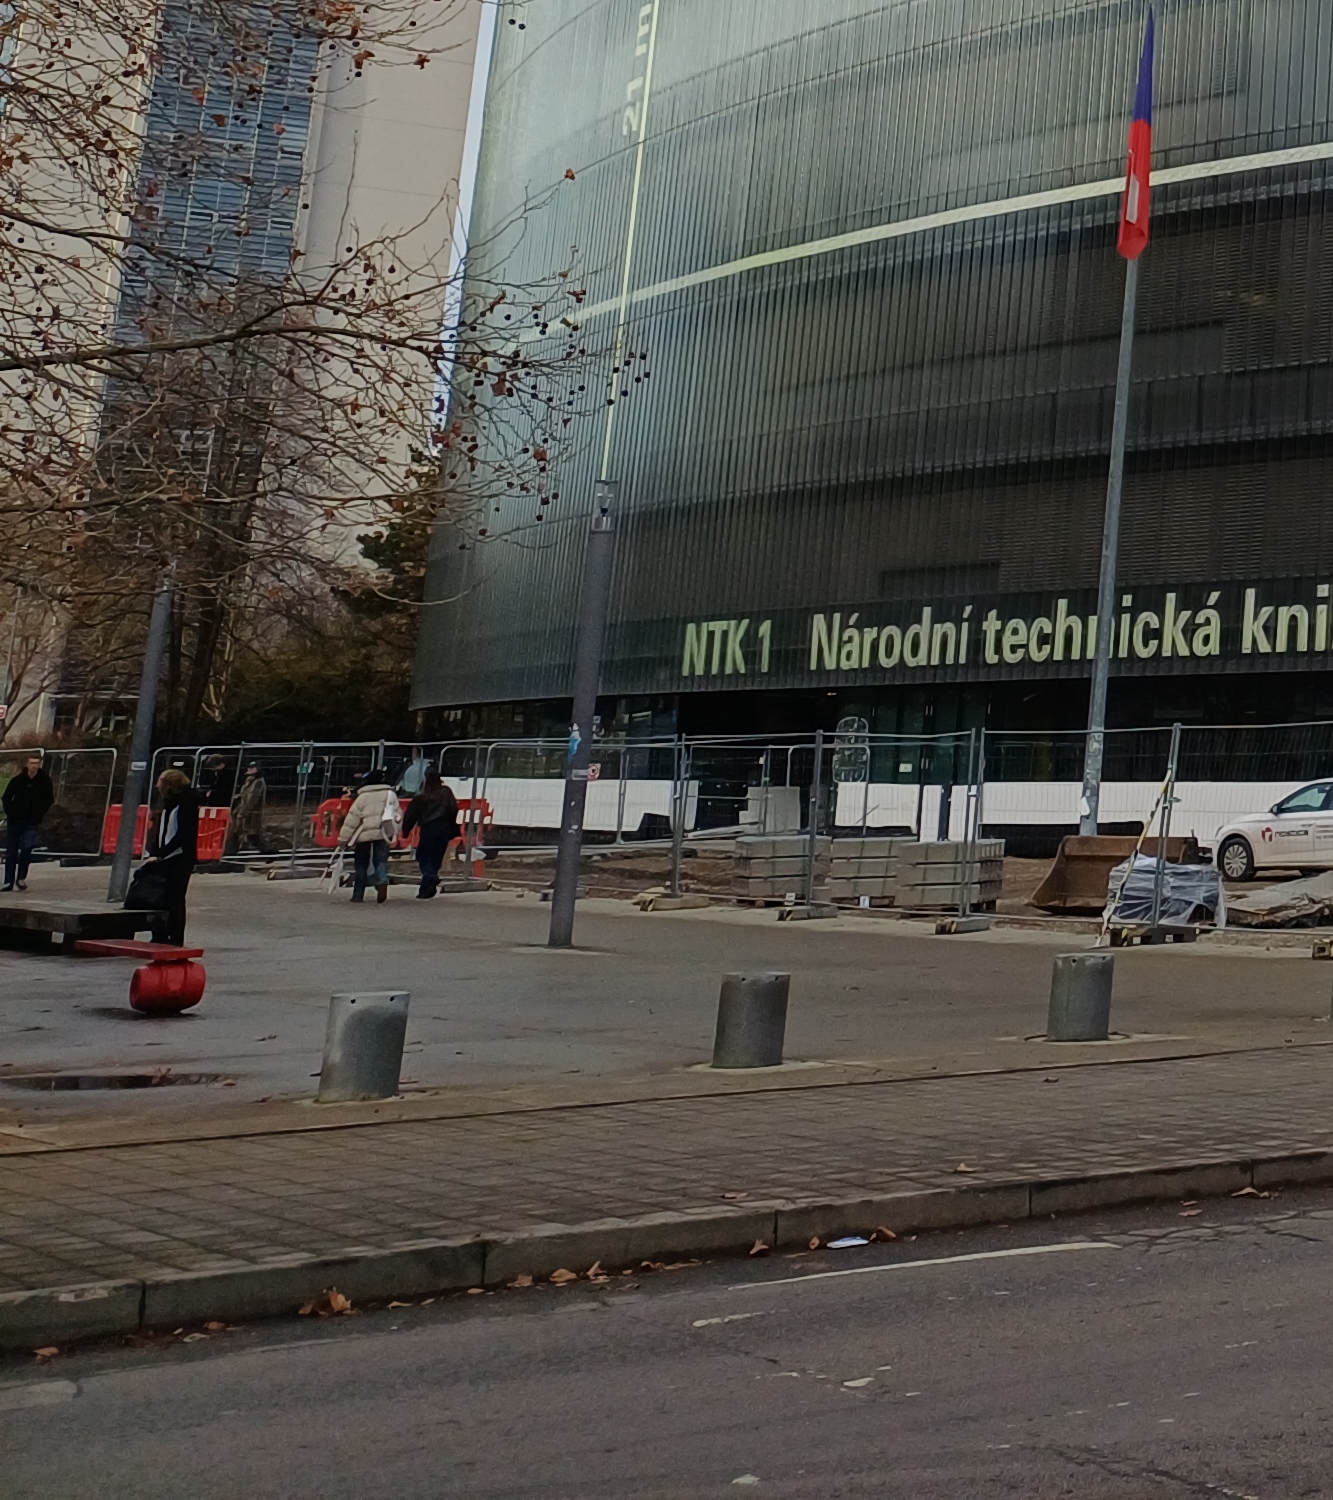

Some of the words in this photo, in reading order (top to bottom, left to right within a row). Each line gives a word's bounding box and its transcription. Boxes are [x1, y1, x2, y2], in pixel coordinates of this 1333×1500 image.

[635, 3, 653, 57] m
[682, 618, 751, 677] NTK
[757, 619, 772, 673] 1
[810, 605, 973, 672] Národní
[982, 590, 1222, 665] technická
